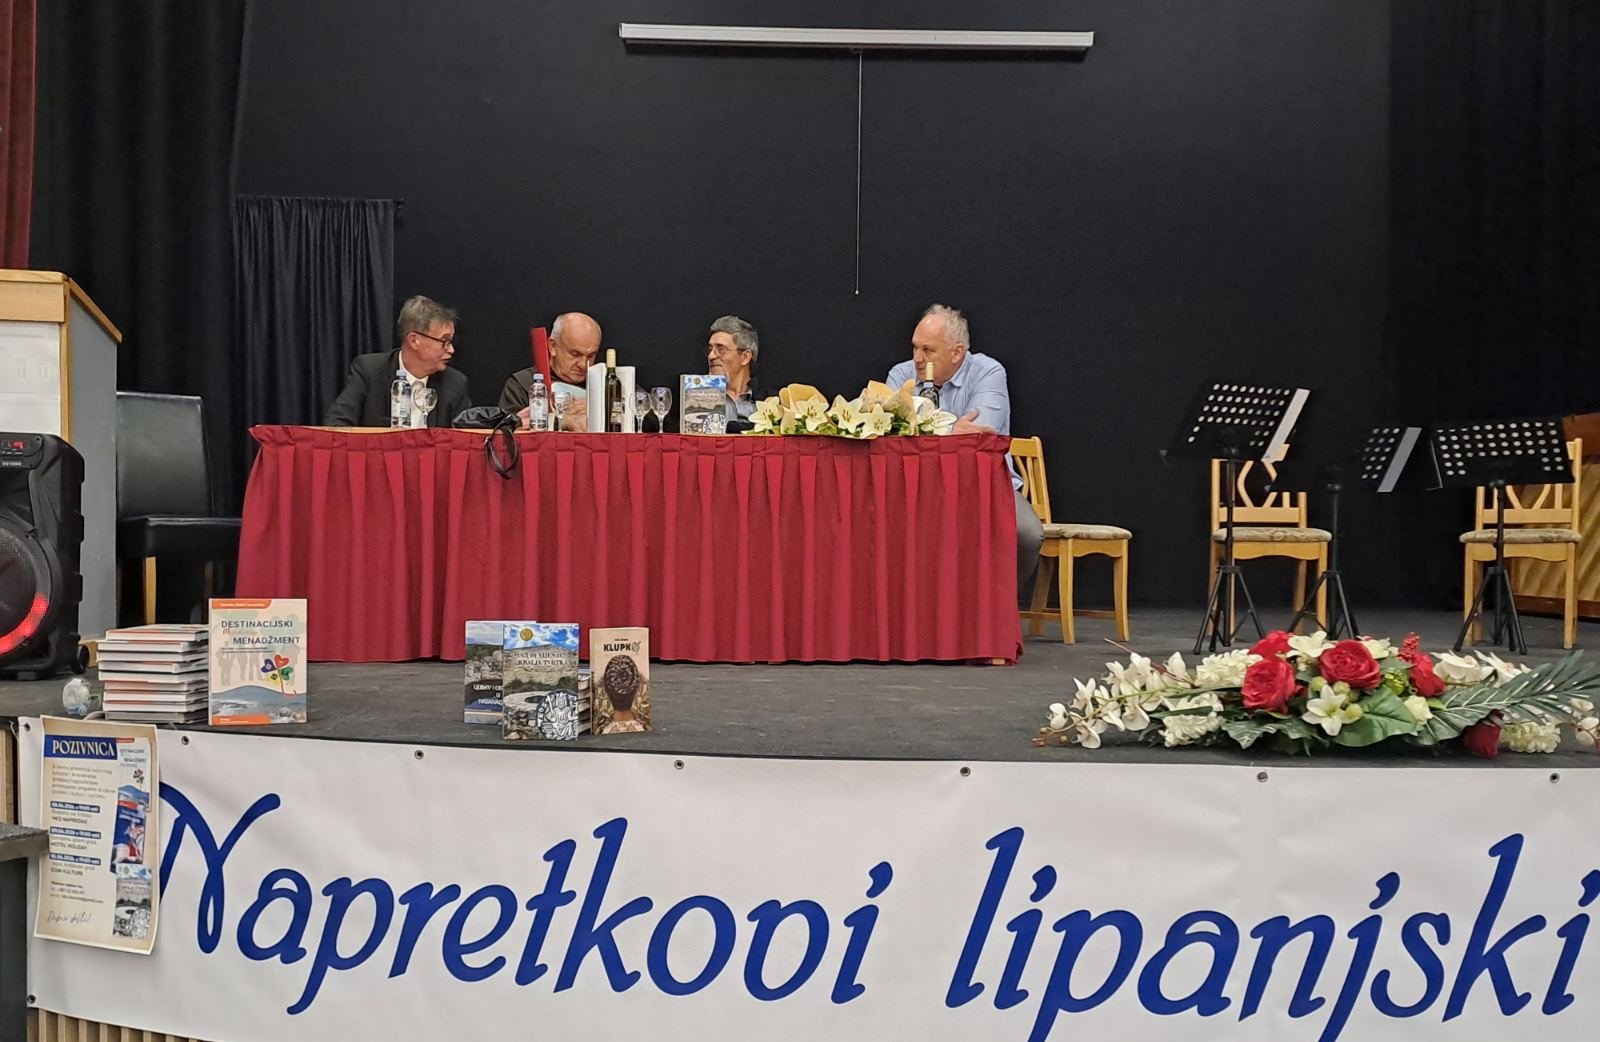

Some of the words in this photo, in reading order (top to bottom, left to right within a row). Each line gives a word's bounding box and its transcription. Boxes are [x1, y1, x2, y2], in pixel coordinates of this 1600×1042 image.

[221, 620, 293, 628] DESTINACIJSKI
[233, 635, 301, 645] MENADŽMENT
[52, 739, 116, 757] POZIVNICA
[160, 781, 893, 1014] Napretkovi
[945, 826, 1600, 1042] lipanjski
